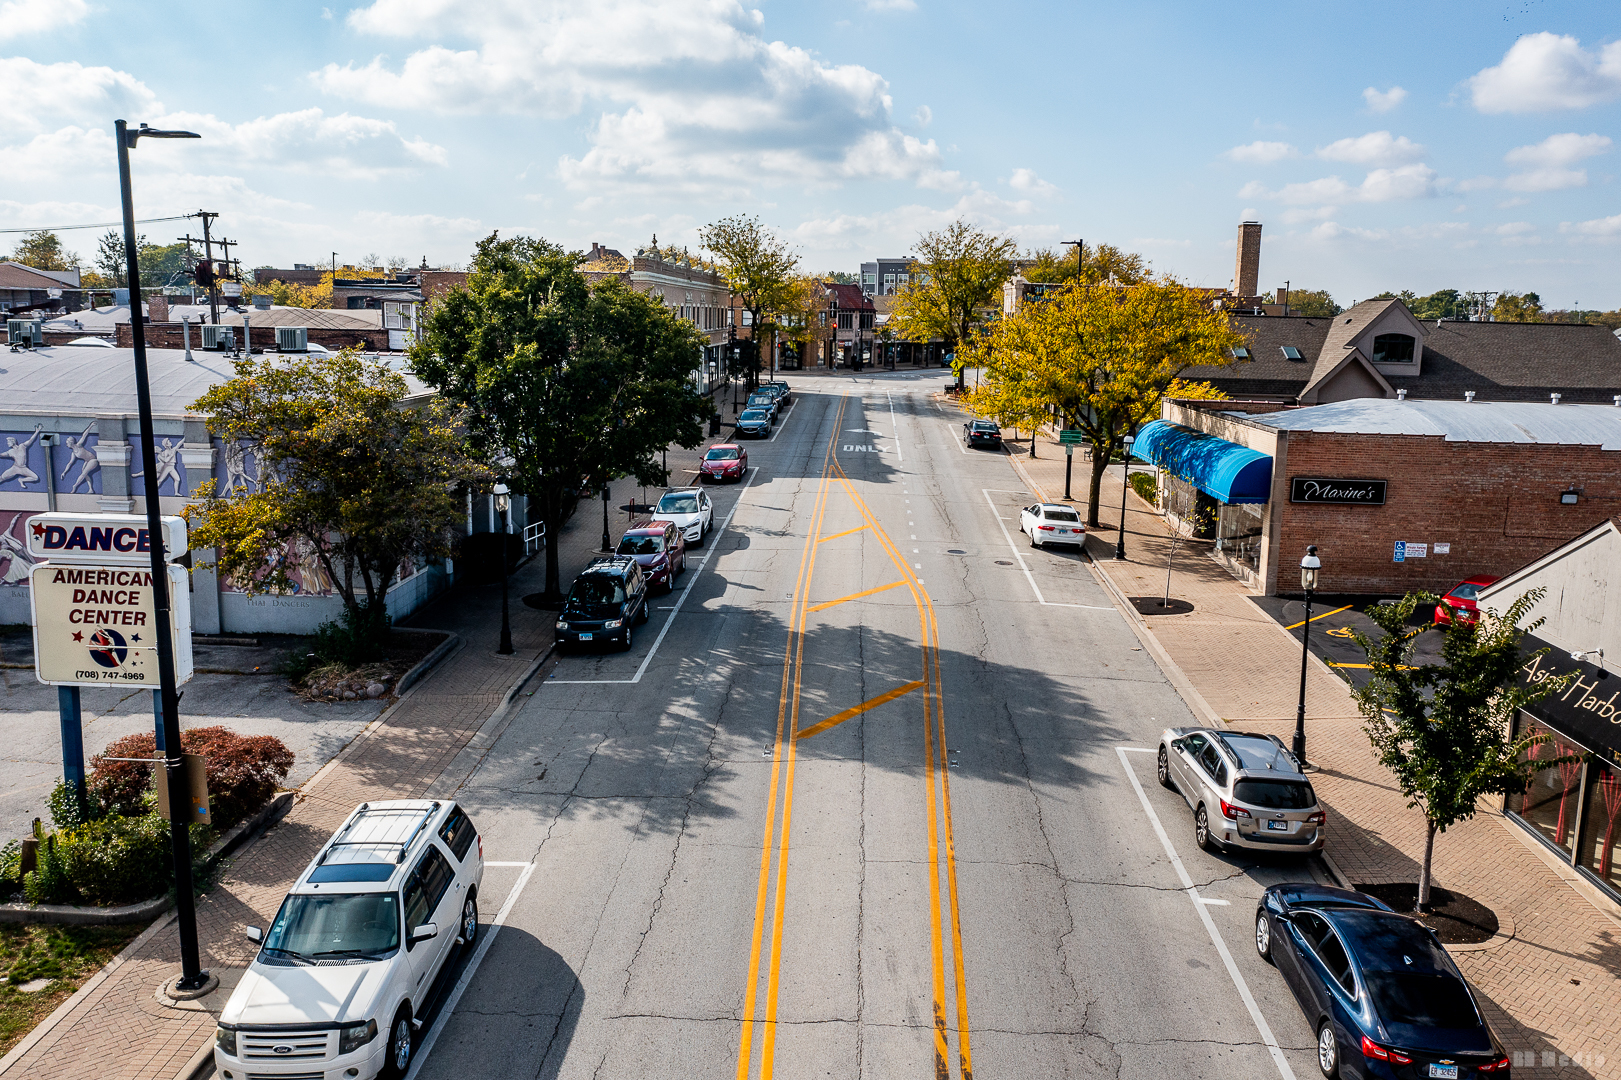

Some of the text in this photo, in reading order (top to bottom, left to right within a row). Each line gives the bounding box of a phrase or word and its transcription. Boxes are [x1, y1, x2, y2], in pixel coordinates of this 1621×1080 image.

[843, 444, 892, 453] ONLY
[1303, 481, 1375, 501] Maxine's
[43, 525, 152, 552] DANCE
[52, 569, 154, 588] AMERICAN
[72, 590, 140, 606] DANCE
[247, 599, 310, 608] THAI DANCERS
[69, 608, 147, 626] CENTER
[75, 670, 145, 681] (708) 747-4969
